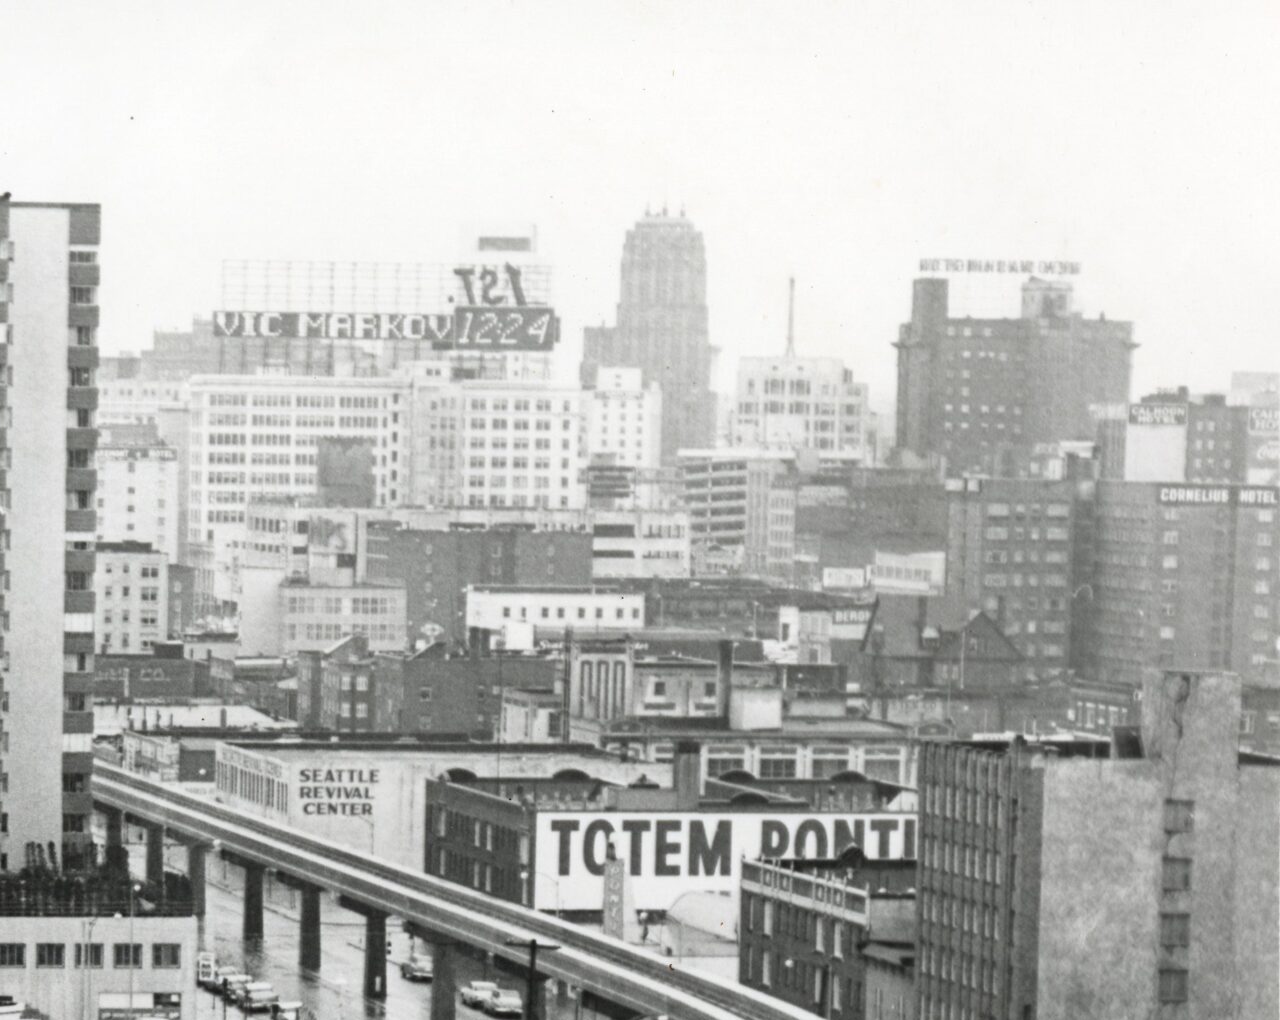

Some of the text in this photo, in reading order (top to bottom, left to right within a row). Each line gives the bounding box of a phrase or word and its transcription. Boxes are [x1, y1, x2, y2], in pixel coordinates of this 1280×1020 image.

[216, 313, 452, 339] VIC MARKOV
[458, 313, 551, 345] 12:24
[1131, 407, 1185, 418] CALHOUN
[1138, 416, 1178, 424] HOTEL
[1160, 487, 1277, 504] CORNELIUS HOTEL
[299, 769, 380, 784] SEATTLE
[300, 786, 375, 800] REVIVAL
[303, 803, 373, 816] CENTER
[551, 819, 732, 877] TOTEM
